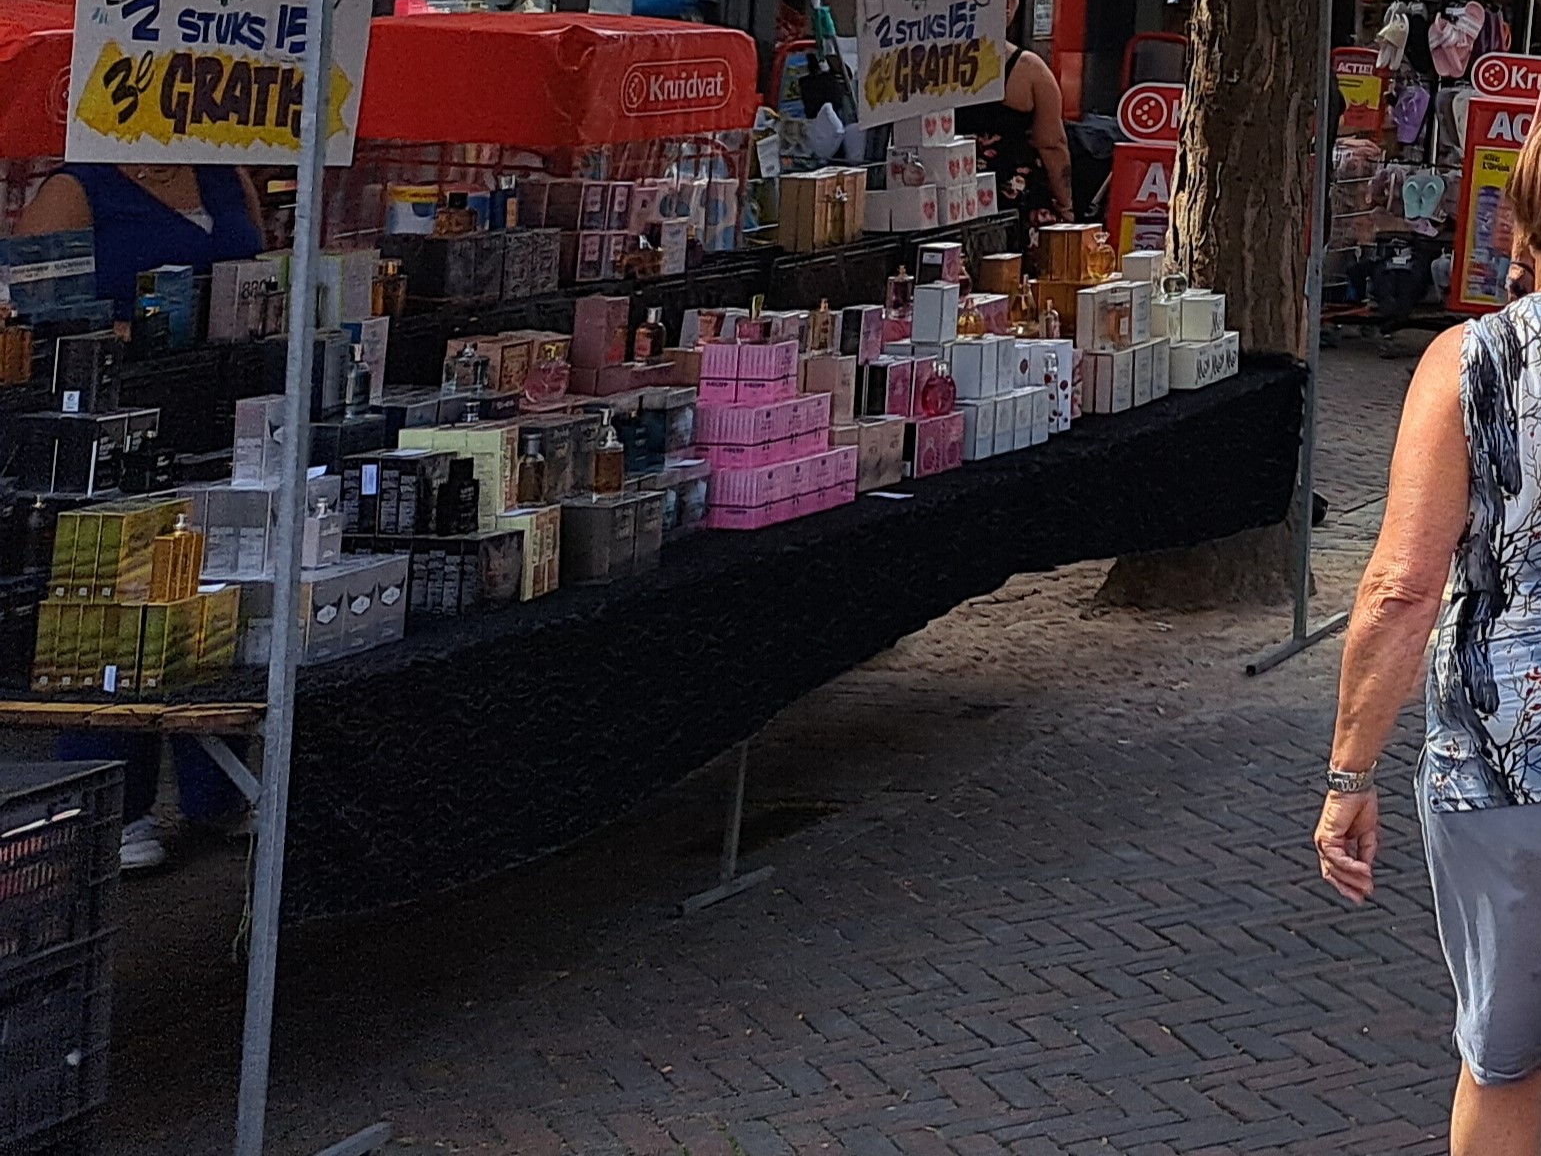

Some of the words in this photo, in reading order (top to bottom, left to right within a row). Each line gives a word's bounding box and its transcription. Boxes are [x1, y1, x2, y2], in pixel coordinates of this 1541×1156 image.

[177, 8, 267, 52] STUKS
[875, 15, 893, 48] 2
[895, 14, 947, 44] STUKS
[649, 72, 724, 101] Kruidvat
[895, 39, 981, 102] GRATIS
